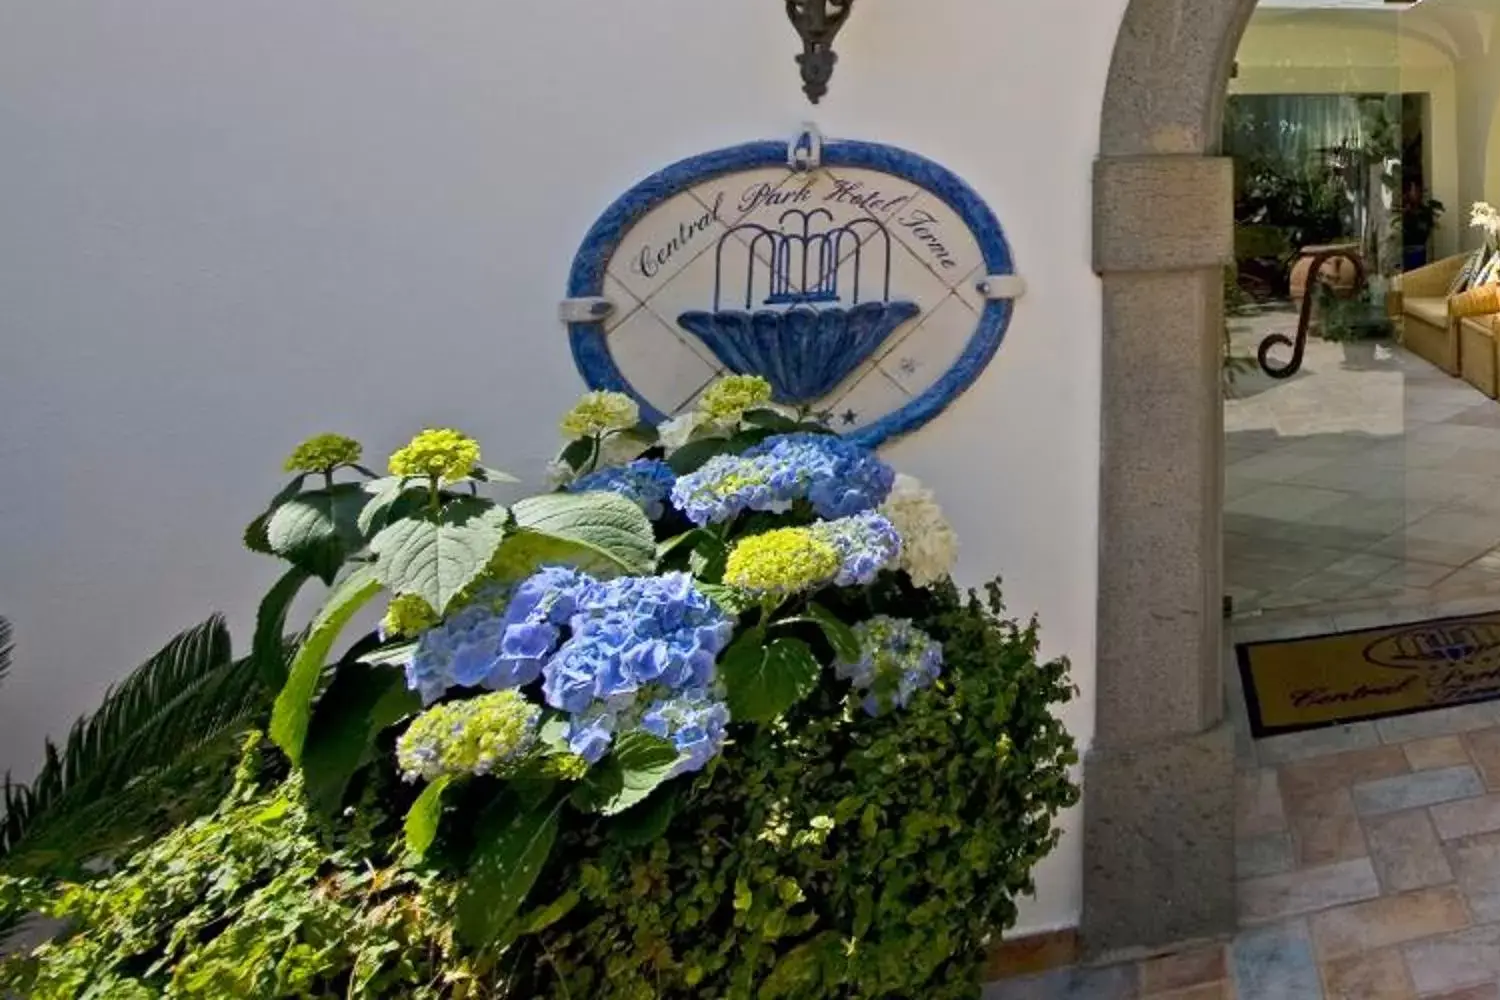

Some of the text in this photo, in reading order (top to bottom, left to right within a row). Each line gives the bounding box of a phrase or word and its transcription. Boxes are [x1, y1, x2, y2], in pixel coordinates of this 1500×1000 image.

[632, 178, 957, 277] Central Park Hotel Terme
[1288, 674, 1420, 709] Central
